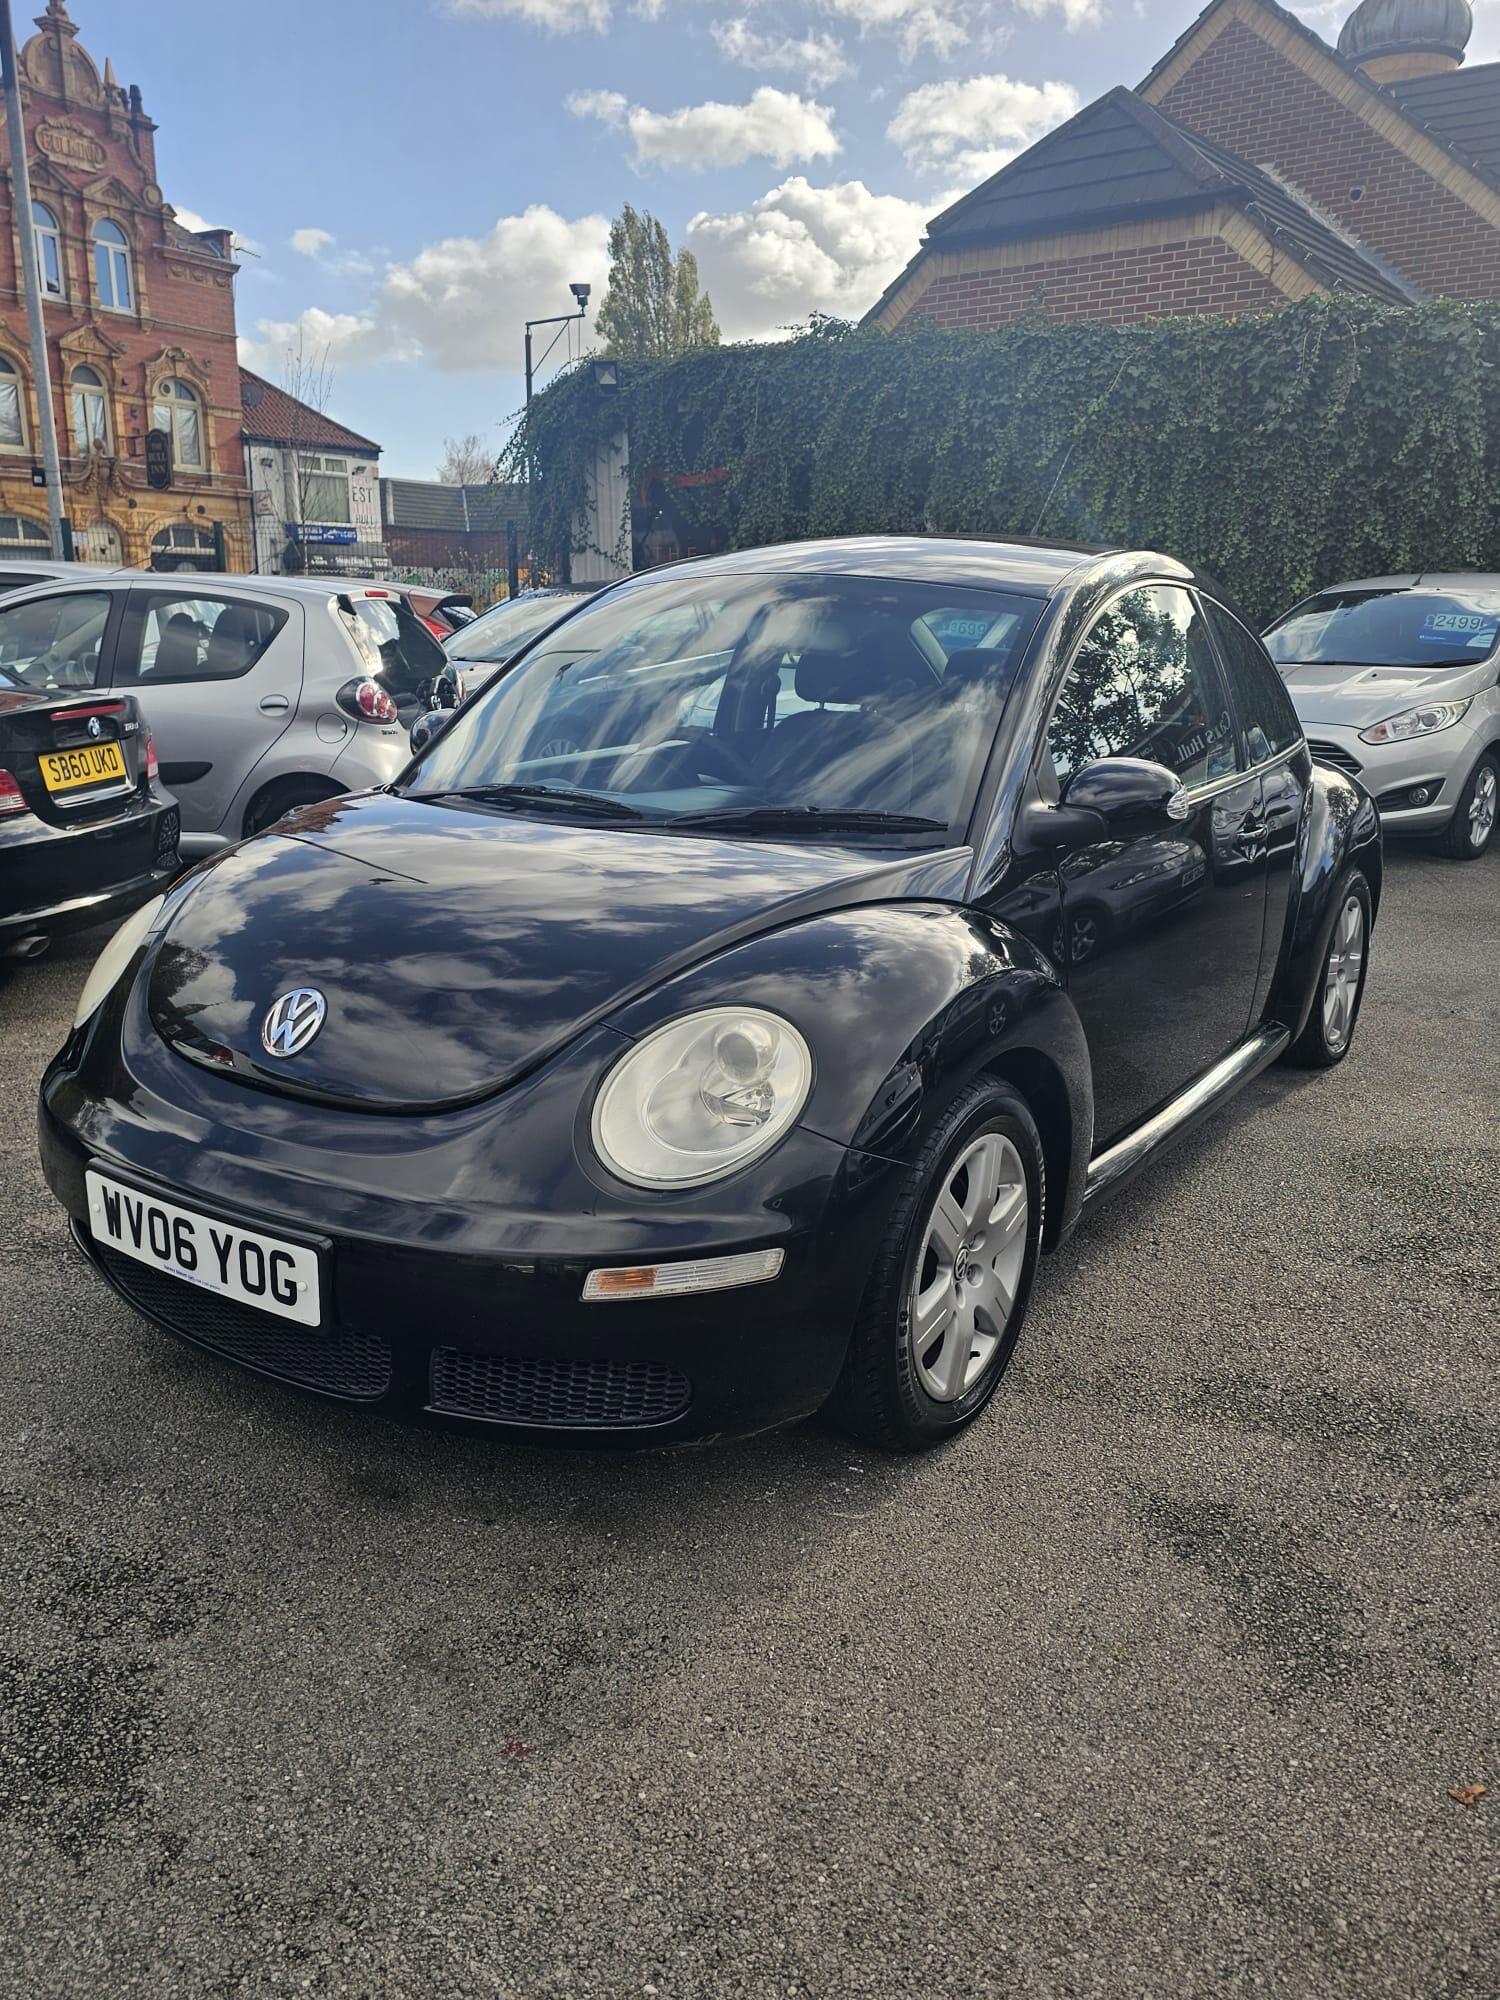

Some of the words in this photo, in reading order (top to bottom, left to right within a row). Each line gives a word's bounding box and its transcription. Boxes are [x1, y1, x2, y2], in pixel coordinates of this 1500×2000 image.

[48, 752, 91, 783] SB60
[89, 747, 119, 774] UKD
[101, 1184, 198, 1271] WV06
[208, 1228, 298, 1307] YOG
